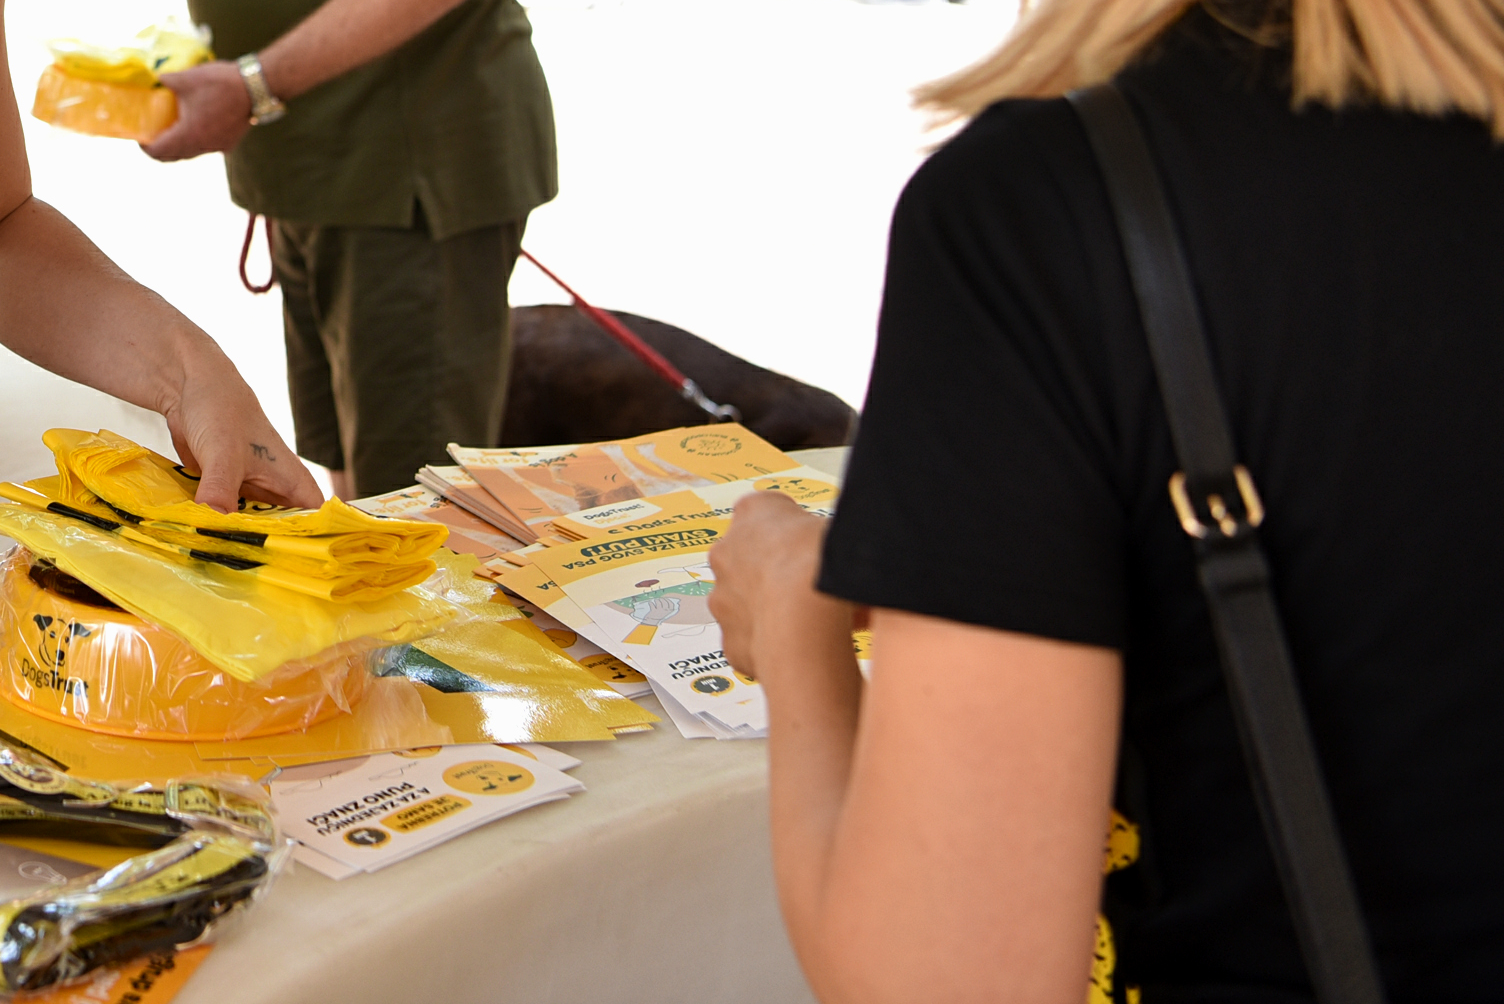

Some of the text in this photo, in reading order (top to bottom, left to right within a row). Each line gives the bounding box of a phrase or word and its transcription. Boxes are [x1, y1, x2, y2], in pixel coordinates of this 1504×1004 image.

[586, 529, 709, 557] SVAKI PUT!
[562, 558, 597, 570] PSA
[598, 549, 644, 563] SVOG
[21, 658, 90, 698] DogsTrut
[671, 660, 730, 680] EDNICU
[362, 781, 415, 804] PUNO
[397, 801, 463, 830] POTREBNA
